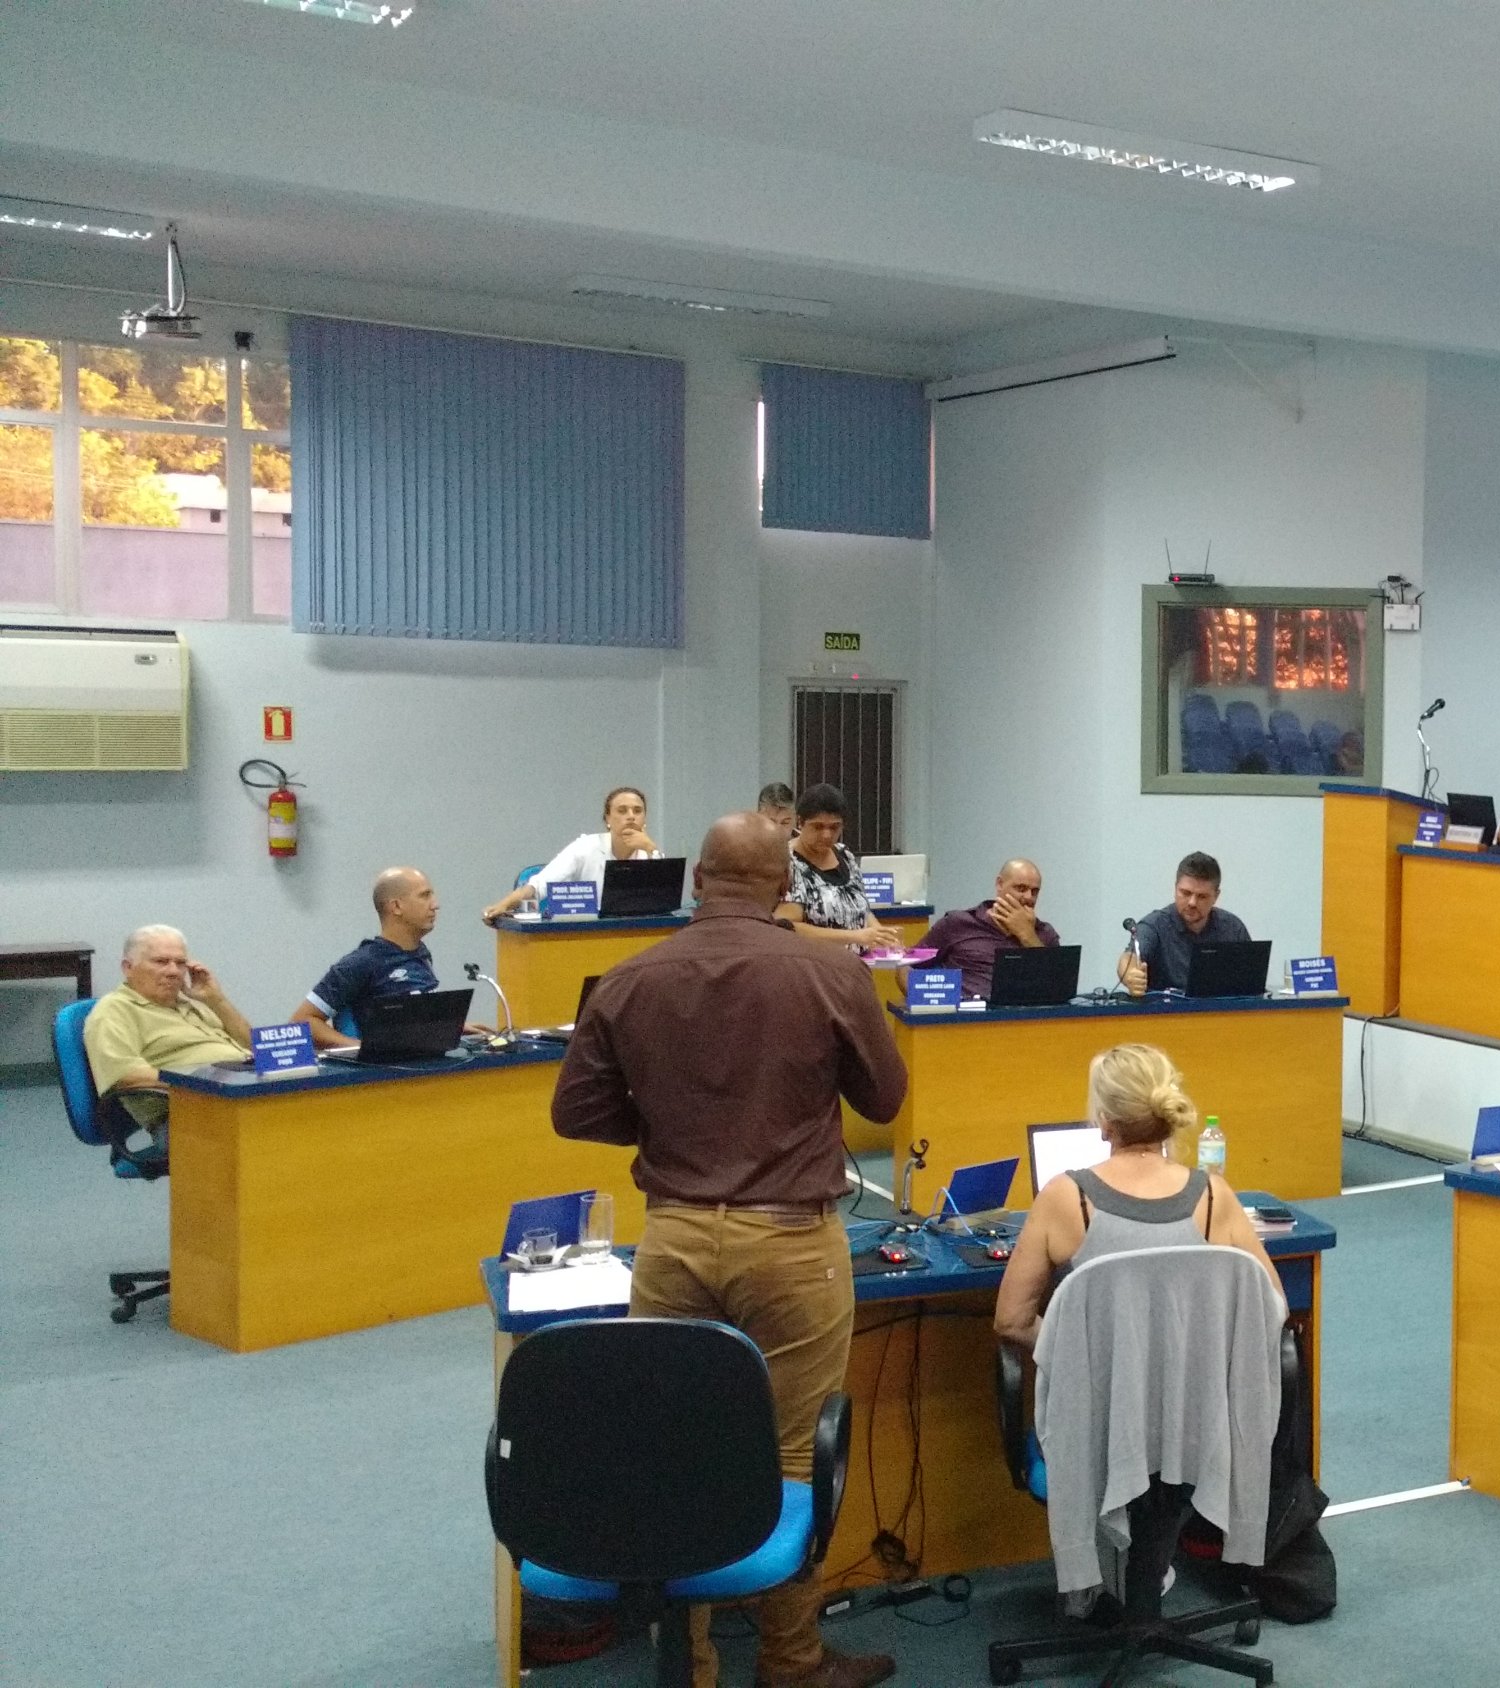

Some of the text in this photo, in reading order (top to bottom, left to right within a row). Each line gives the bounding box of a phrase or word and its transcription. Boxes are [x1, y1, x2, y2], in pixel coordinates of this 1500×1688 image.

[826, 634, 859, 649] SAÍDA
[925, 974, 945, 983] PRETO
[260, 1025, 302, 1042] NELSON
